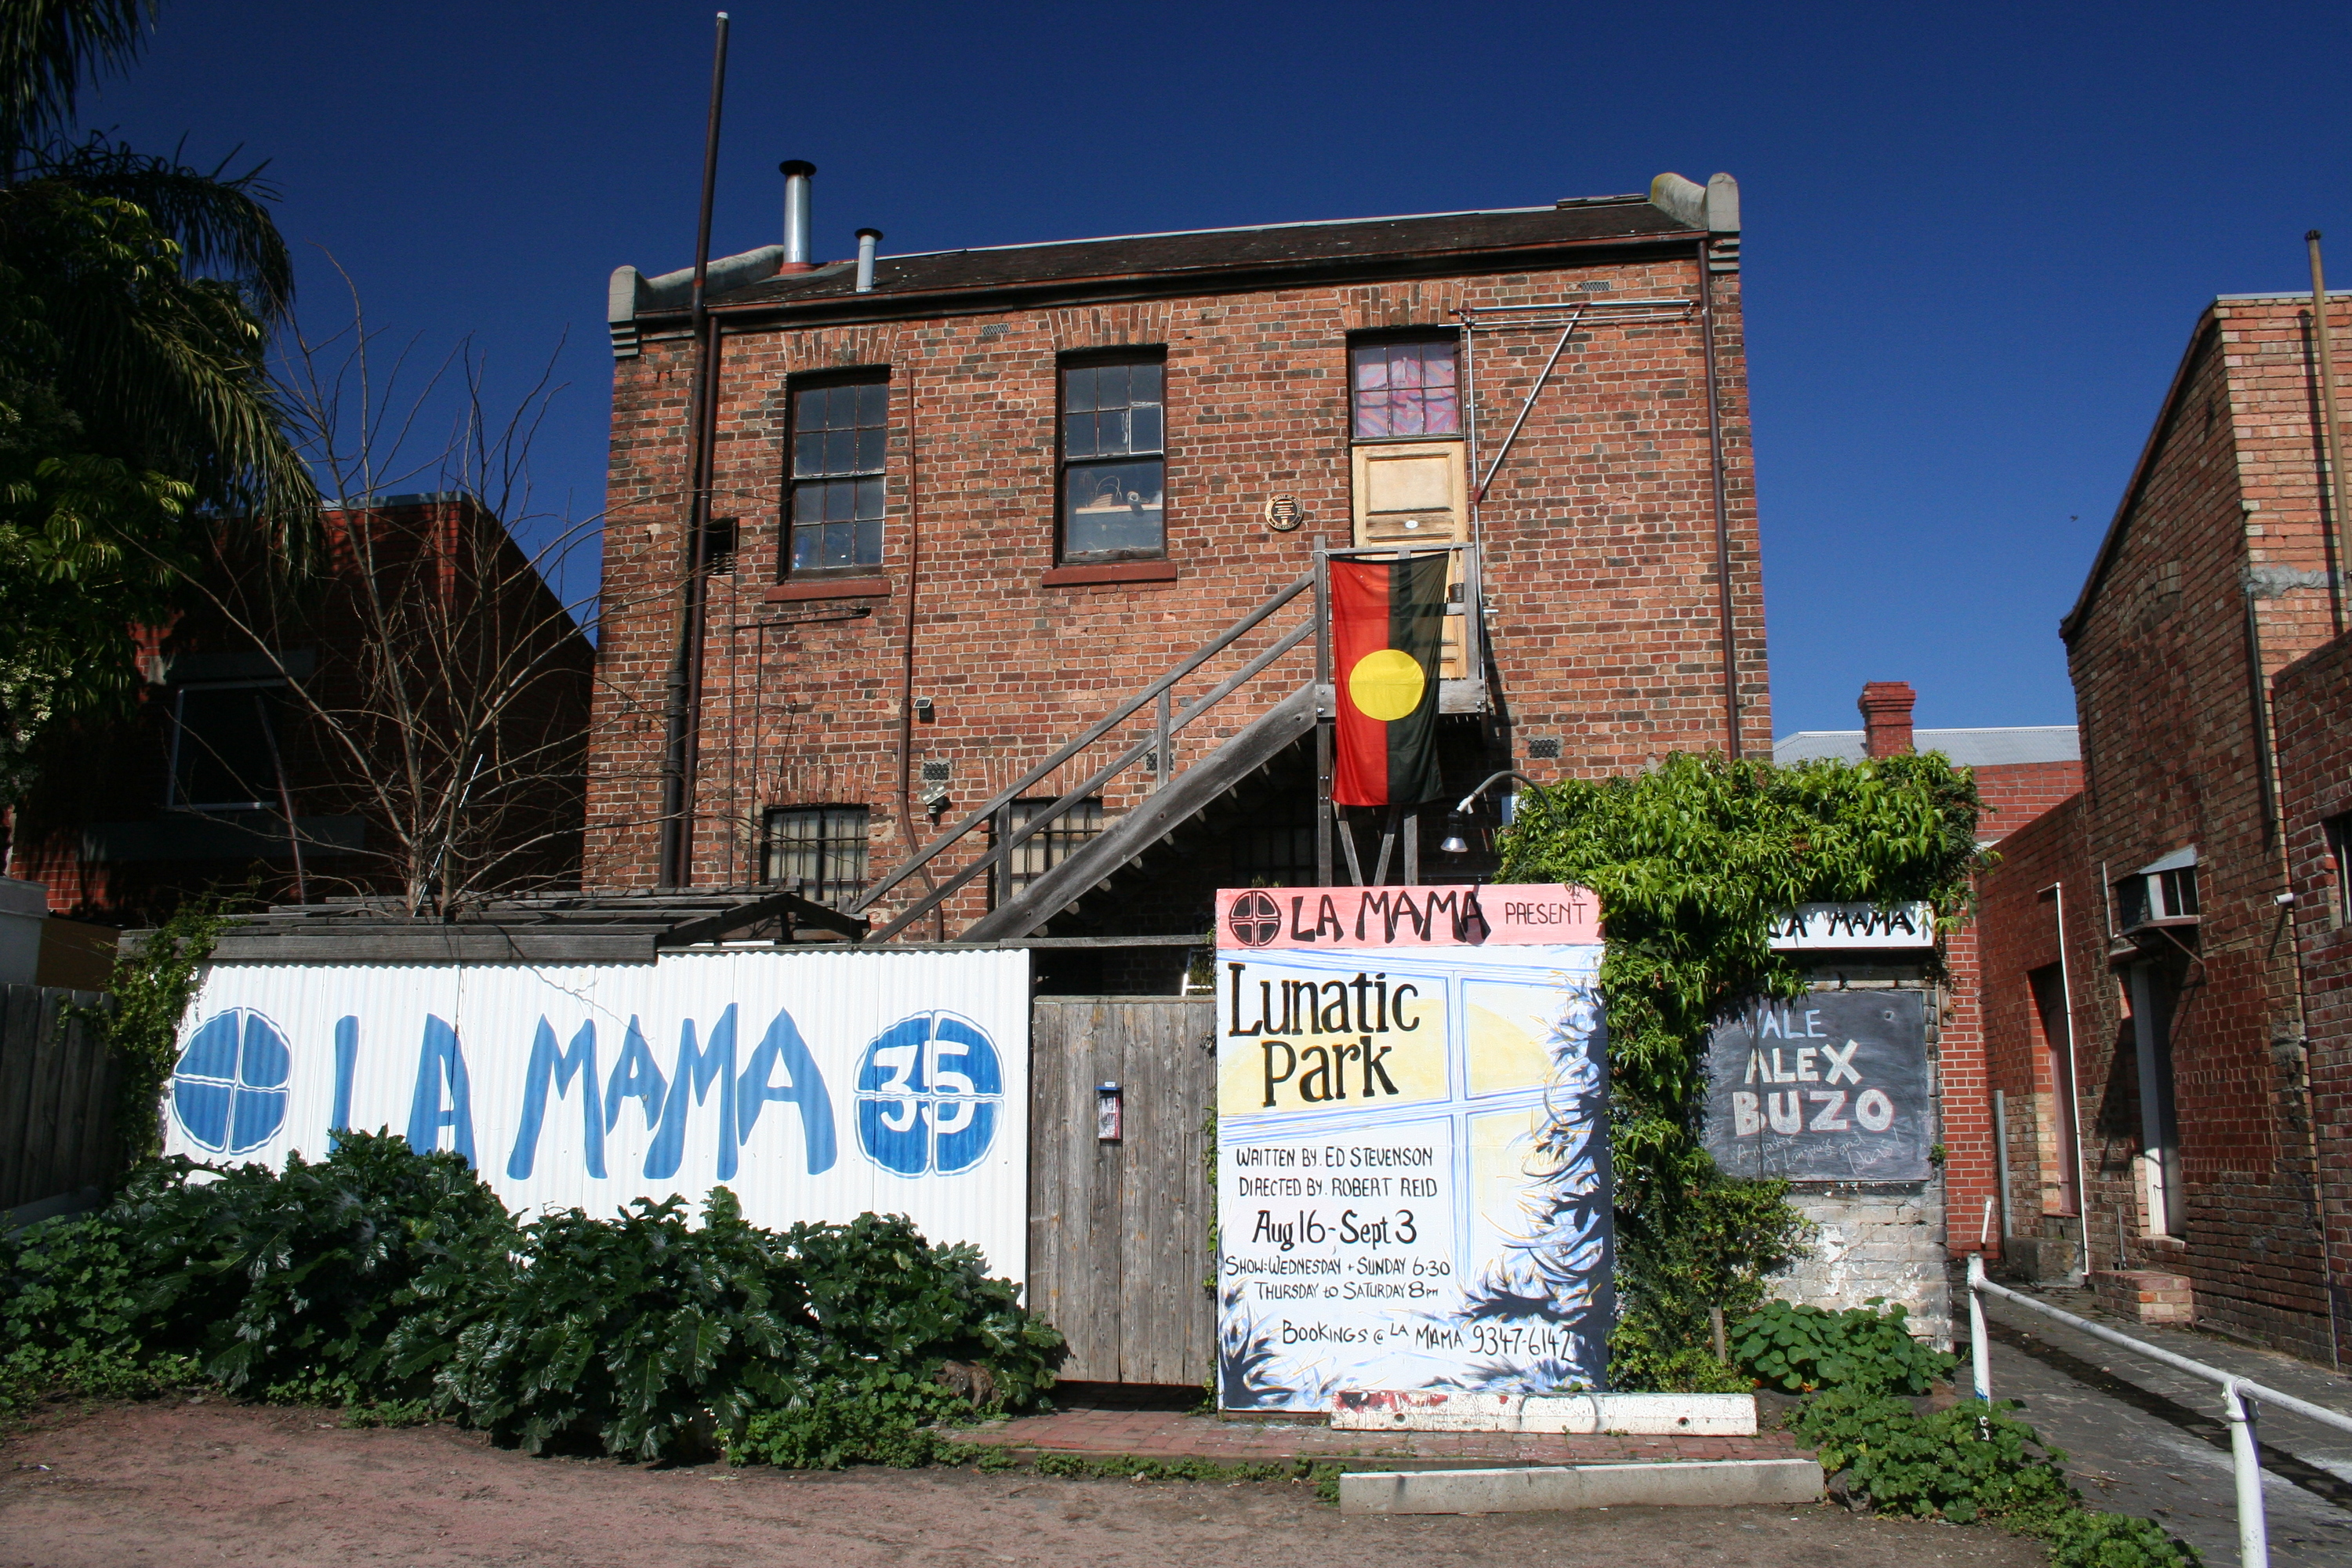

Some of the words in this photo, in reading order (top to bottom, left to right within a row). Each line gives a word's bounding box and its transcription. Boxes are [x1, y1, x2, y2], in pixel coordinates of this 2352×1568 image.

[1290, 894, 1344, 942] LA
[1356, 890, 1491, 943] MAMA
[1505, 902, 1588, 925] PRESENT
[1828, 910, 1916, 937] MAMA
[1228, 962, 1420, 1037] Lunatic
[1261, 1036, 1399, 1107] Park
[1744, 1039, 1863, 1085] ALEX
[506, 1001, 837, 1181] MAMA
[873, 1040, 975, 1134] 35
[1733, 1088, 1893, 1136] BUZO
[1236, 1147, 1295, 1167] WRITTEN
[1326, 1146, 1345, 1167] ED
[1349, 1147, 1433, 1167] STEVENSON
[1239, 1176, 1301, 1197] DIRECTED
[1332, 1178, 1392, 1197] ROBERT
[1400, 1178, 1438, 1197] REID
[1251, 1210, 1294, 1252] Aug
[1395, 1209, 1417, 1244] 3
[1356, 1256, 1406, 1276] SUNDAY
[1254, 1281, 1319, 1301] THURSDAY
[1342, 1281, 1406, 1300] SATURDAY
[1282, 1318, 1369, 1345] BOOKINGS
[1373, 1330, 1385, 1345] @
[1389, 1322, 1410, 1338] LA
[1415, 1323, 1464, 1351] MAMA
[1468, 1325, 1576, 1363] 9347-6142
